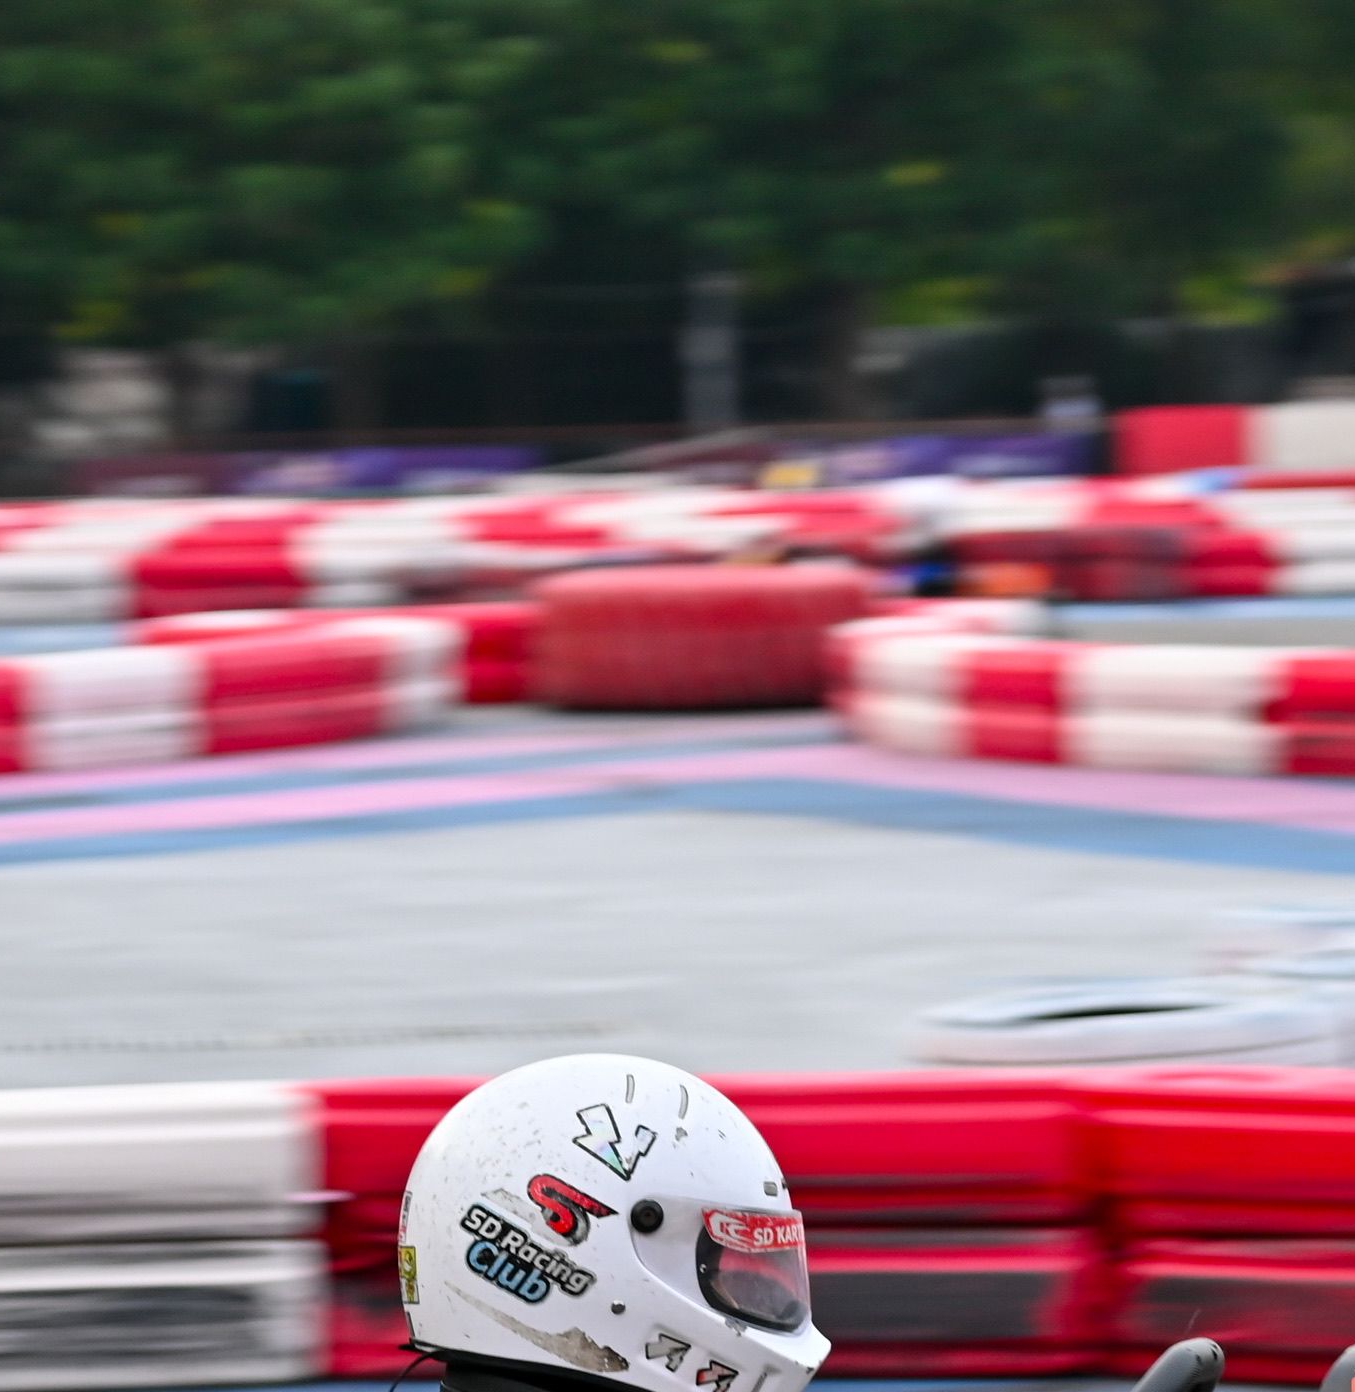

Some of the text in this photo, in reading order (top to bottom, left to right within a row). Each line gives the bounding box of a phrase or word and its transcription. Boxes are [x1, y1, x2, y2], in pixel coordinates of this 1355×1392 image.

[464, 1208, 503, 1240] SD
[501, 1229, 589, 1294] Racing
[753, 1226, 774, 1247] SD
[468, 1240, 548, 1301] Club
